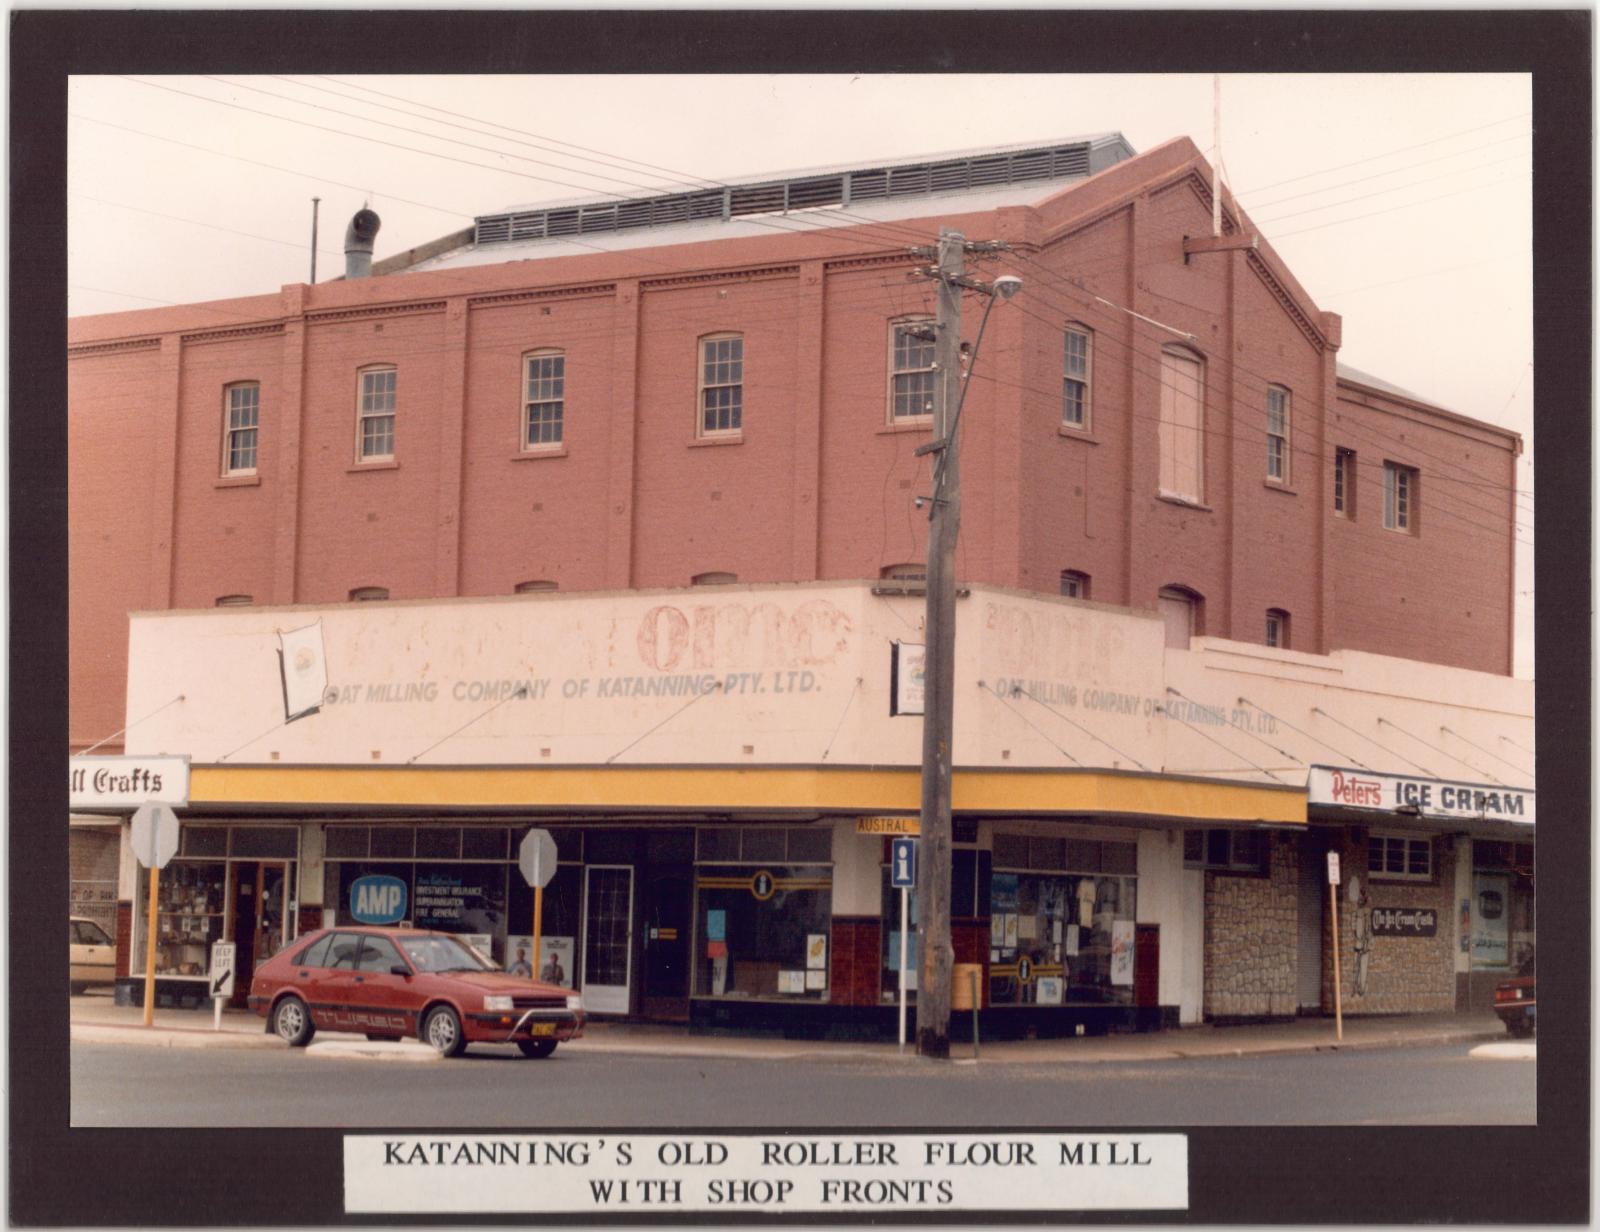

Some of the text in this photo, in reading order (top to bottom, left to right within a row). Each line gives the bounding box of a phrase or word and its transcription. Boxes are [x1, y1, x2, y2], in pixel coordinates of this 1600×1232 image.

[367, 681, 438, 703] MILLING
[452, 679, 551, 701] COMPANY
[562, 678, 590, 698] OF
[597, 674, 716, 698] KATANNING
[724, 672, 766, 694] PTY.
[773, 670, 822, 693] LTD.
[1029, 679, 1078, 706] MILLING
[1082, 688, 1141, 715] COMPANY
[1164, 699, 1226, 727] KATANNING
[69, 768, 163, 793] ll Crafts
[1331, 768, 1381, 806] Peters
[1395, 782, 1525, 816] ICE CREAM
[858, 818, 909, 832] AUSTRAL
[356, 885, 401, 915] AMP
[1395, 910, 1415, 930] Cream
[317, 1011, 406, 1030] TURBO
